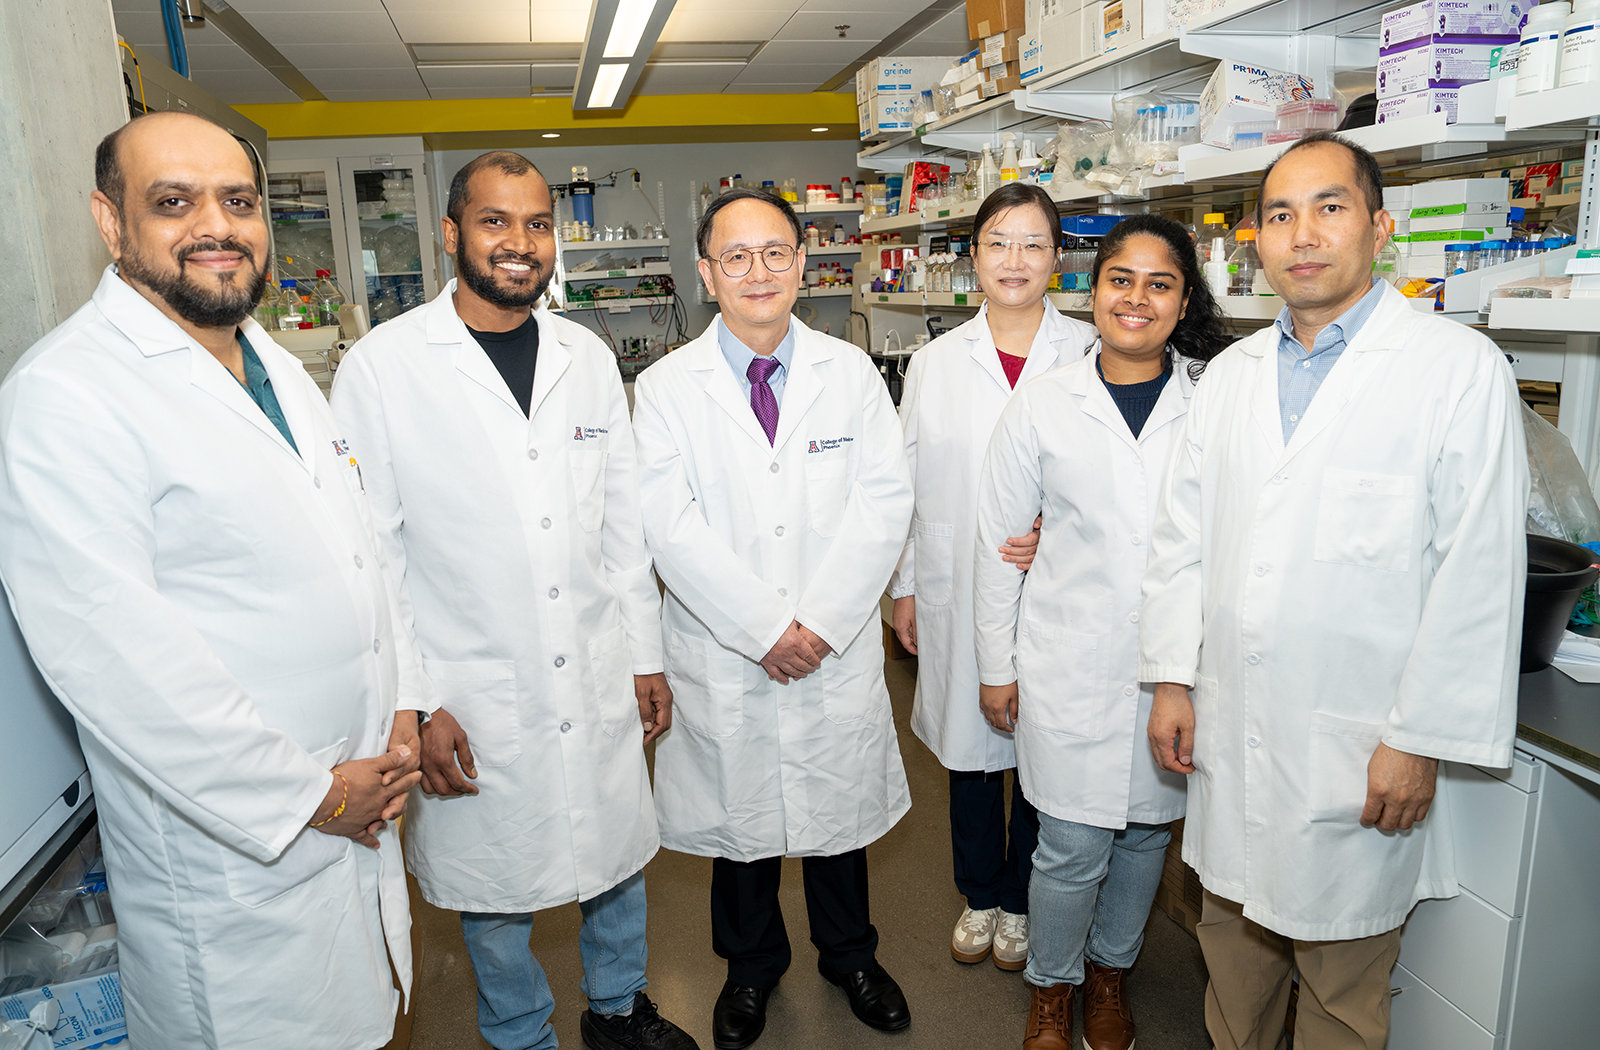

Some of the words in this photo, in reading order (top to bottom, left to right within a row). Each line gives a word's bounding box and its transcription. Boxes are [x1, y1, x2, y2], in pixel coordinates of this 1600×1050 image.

[1383, 10, 1412, 22] KIMTECH
[1023, 44, 1043, 61] greinr
[1380, 55, 1407, 67] KIMTECH
[1499, 62, 1519, 72] TECH
[884, 68, 912, 77] grener
[1233, 64, 1269, 77] PR1MA
[1379, 98, 1406, 108] KIMTECH
[885, 106, 912, 115] grener
[71, 1015, 86, 1041] FALCON
